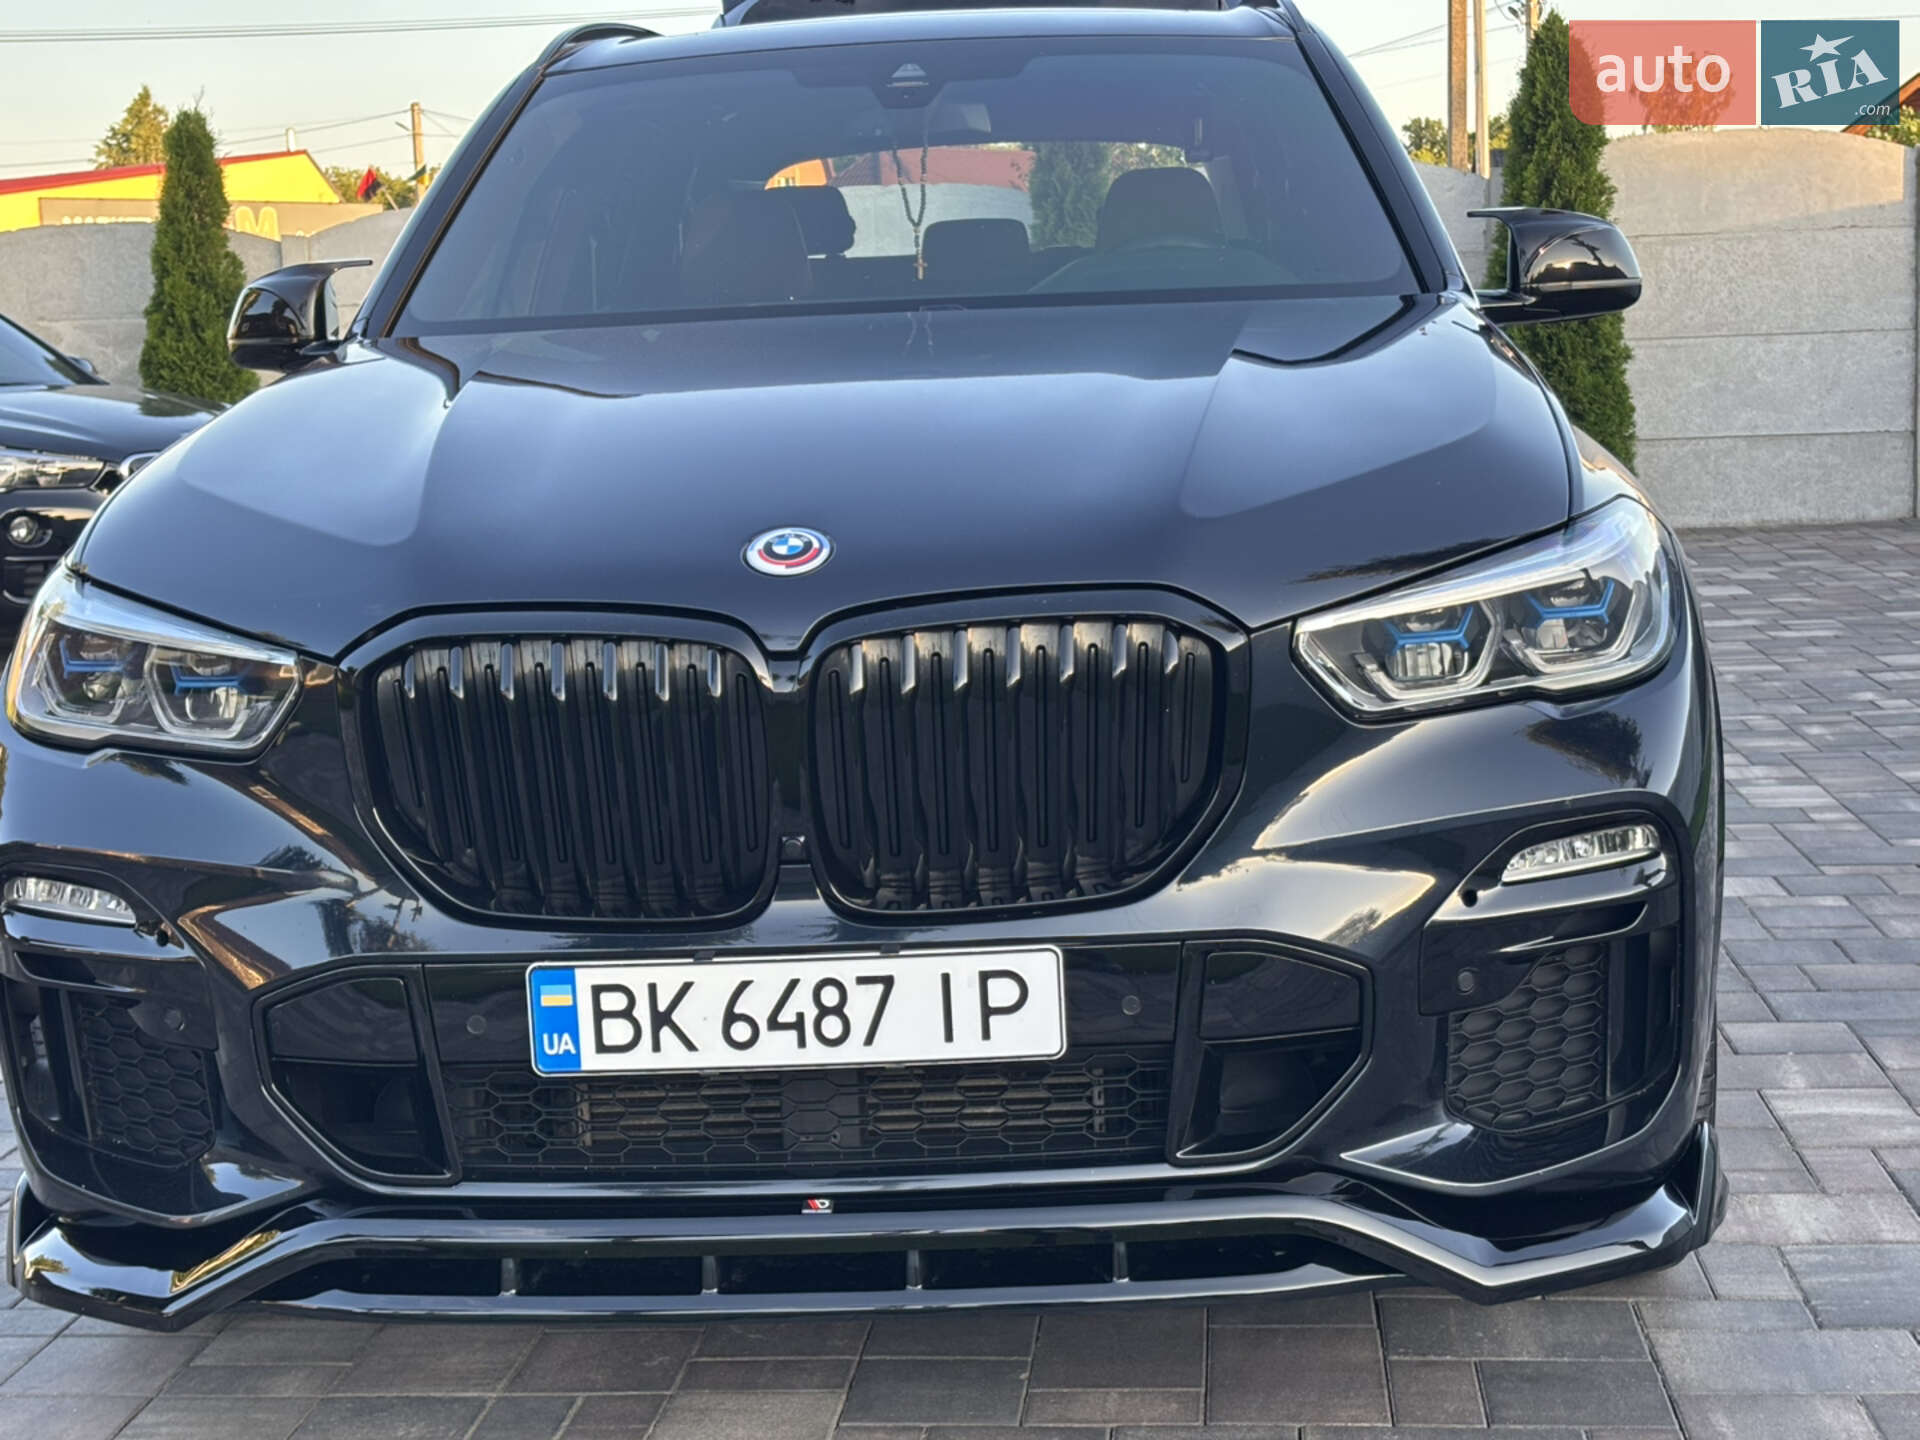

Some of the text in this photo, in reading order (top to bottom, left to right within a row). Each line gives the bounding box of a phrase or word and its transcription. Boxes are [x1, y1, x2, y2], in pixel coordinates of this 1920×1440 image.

[590, 970, 1029, 1053] BK 6487 IP
[543, 1033, 576, 1055] UA
